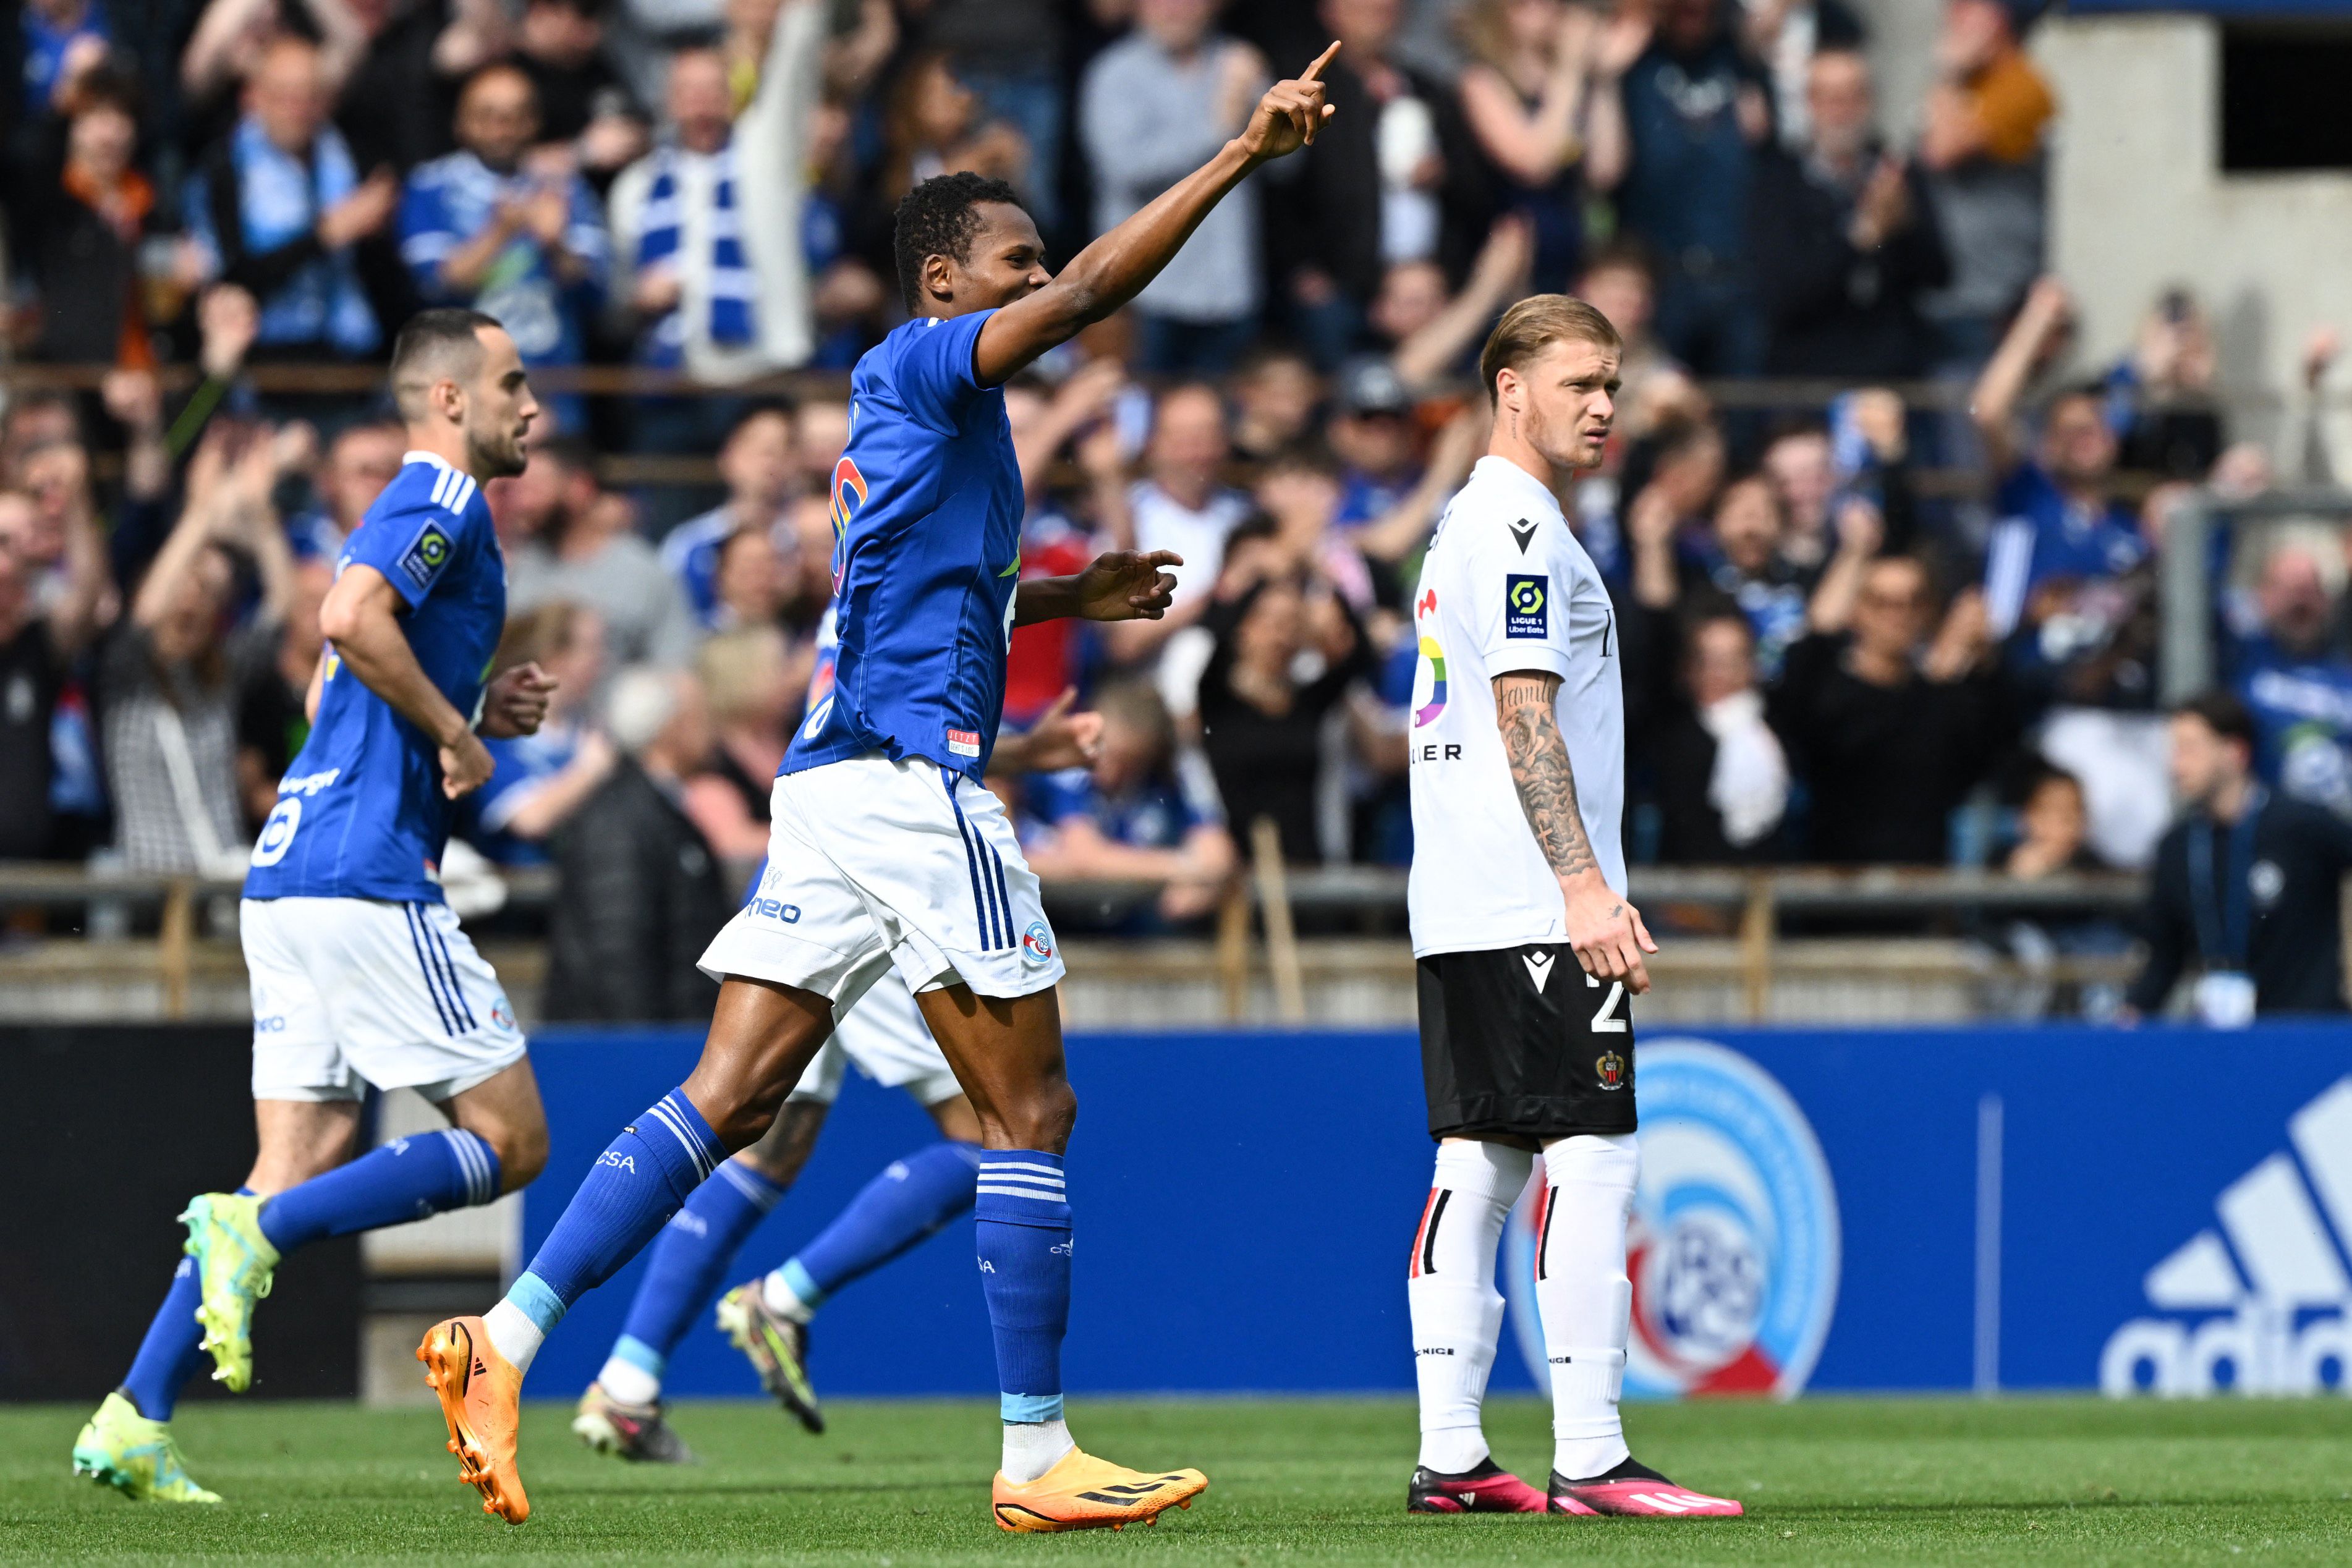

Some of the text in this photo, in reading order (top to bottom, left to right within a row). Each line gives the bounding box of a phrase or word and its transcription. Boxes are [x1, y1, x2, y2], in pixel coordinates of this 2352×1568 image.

[1511, 617, 1537, 625] LIGUE
[1526, 625, 1545, 634] Eats
[949, 731, 977, 743] JETZT
[595, 1151, 635, 1175] CSA
